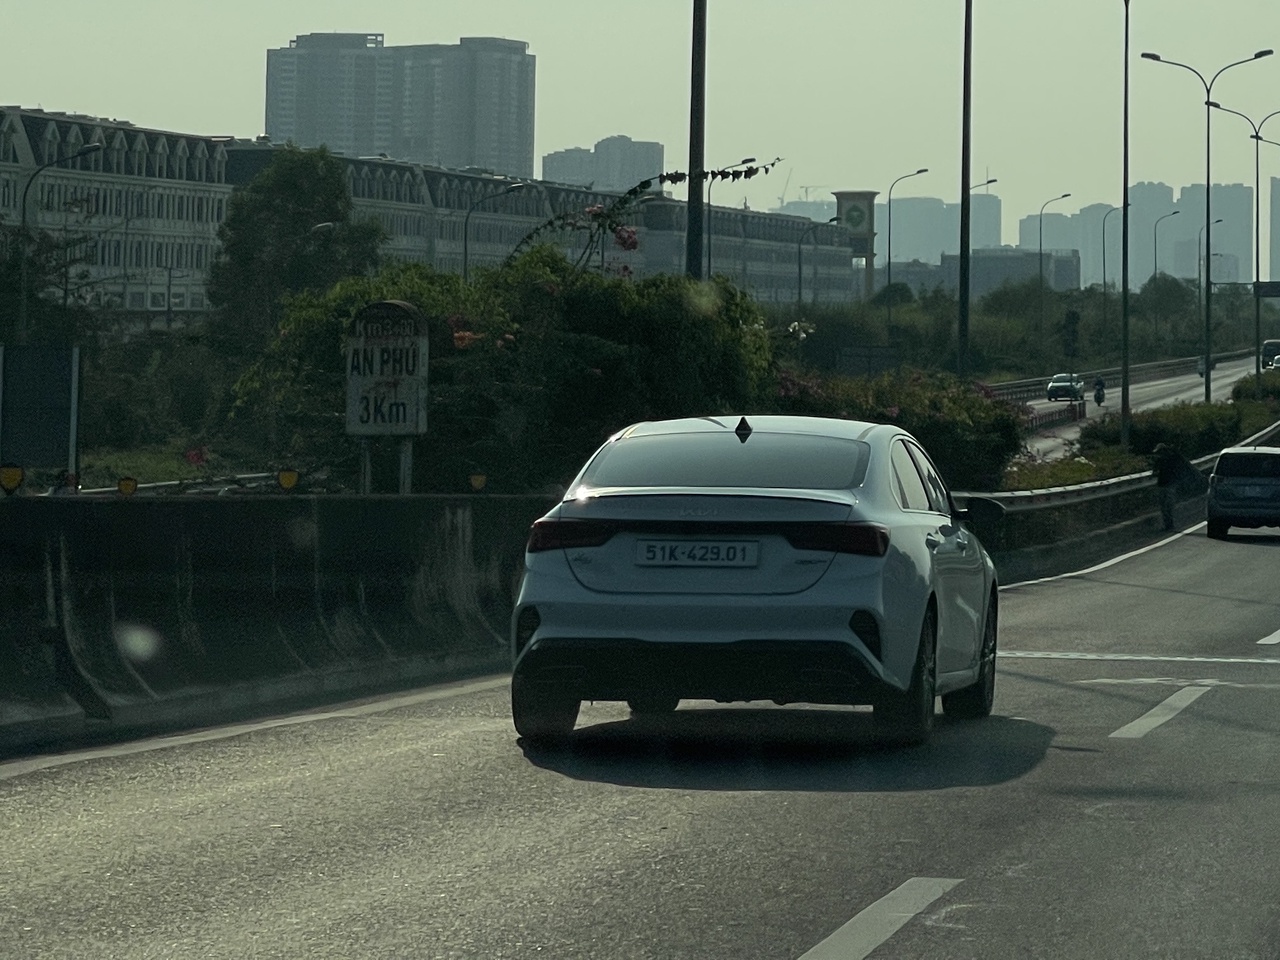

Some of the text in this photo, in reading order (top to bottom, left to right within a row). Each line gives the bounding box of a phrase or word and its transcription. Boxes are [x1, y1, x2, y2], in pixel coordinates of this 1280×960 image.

[350, 348, 374, 376] AN
[380, 341, 417, 376] PHÚ
[359, 395, 407, 424] 3Km
[645, 544, 747, 562] 51K-429.01
